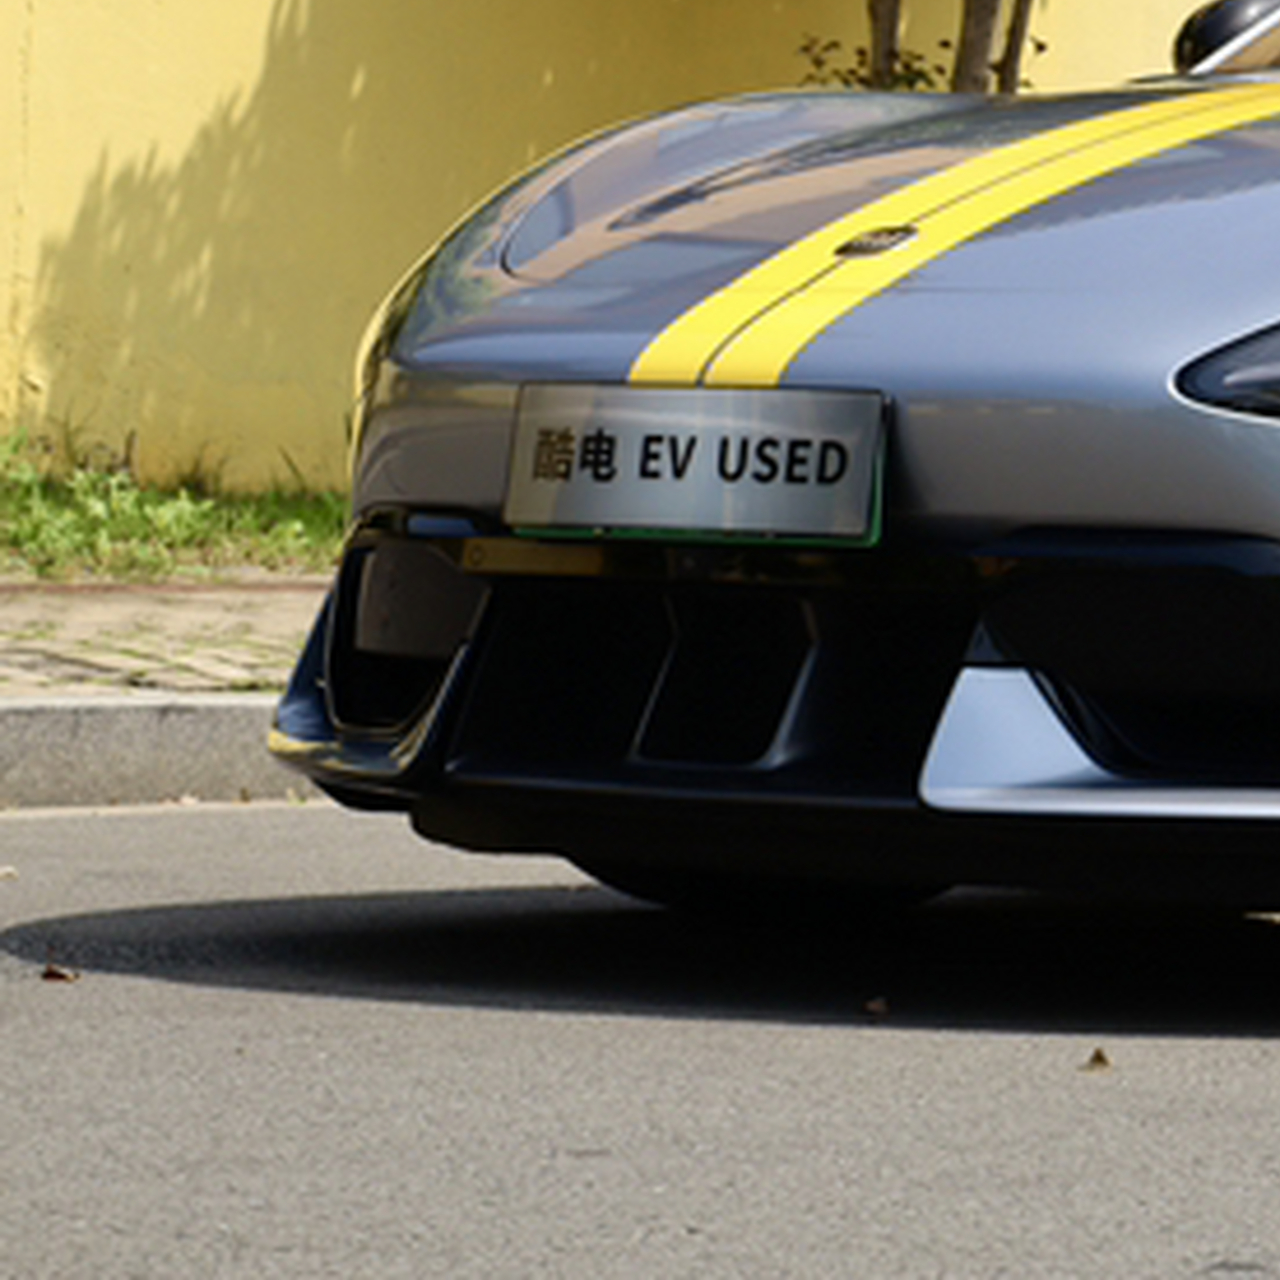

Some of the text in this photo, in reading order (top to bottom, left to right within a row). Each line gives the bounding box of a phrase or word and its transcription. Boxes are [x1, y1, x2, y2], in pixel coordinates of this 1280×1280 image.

[533, 427, 849, 485] 酷电 EV USED
